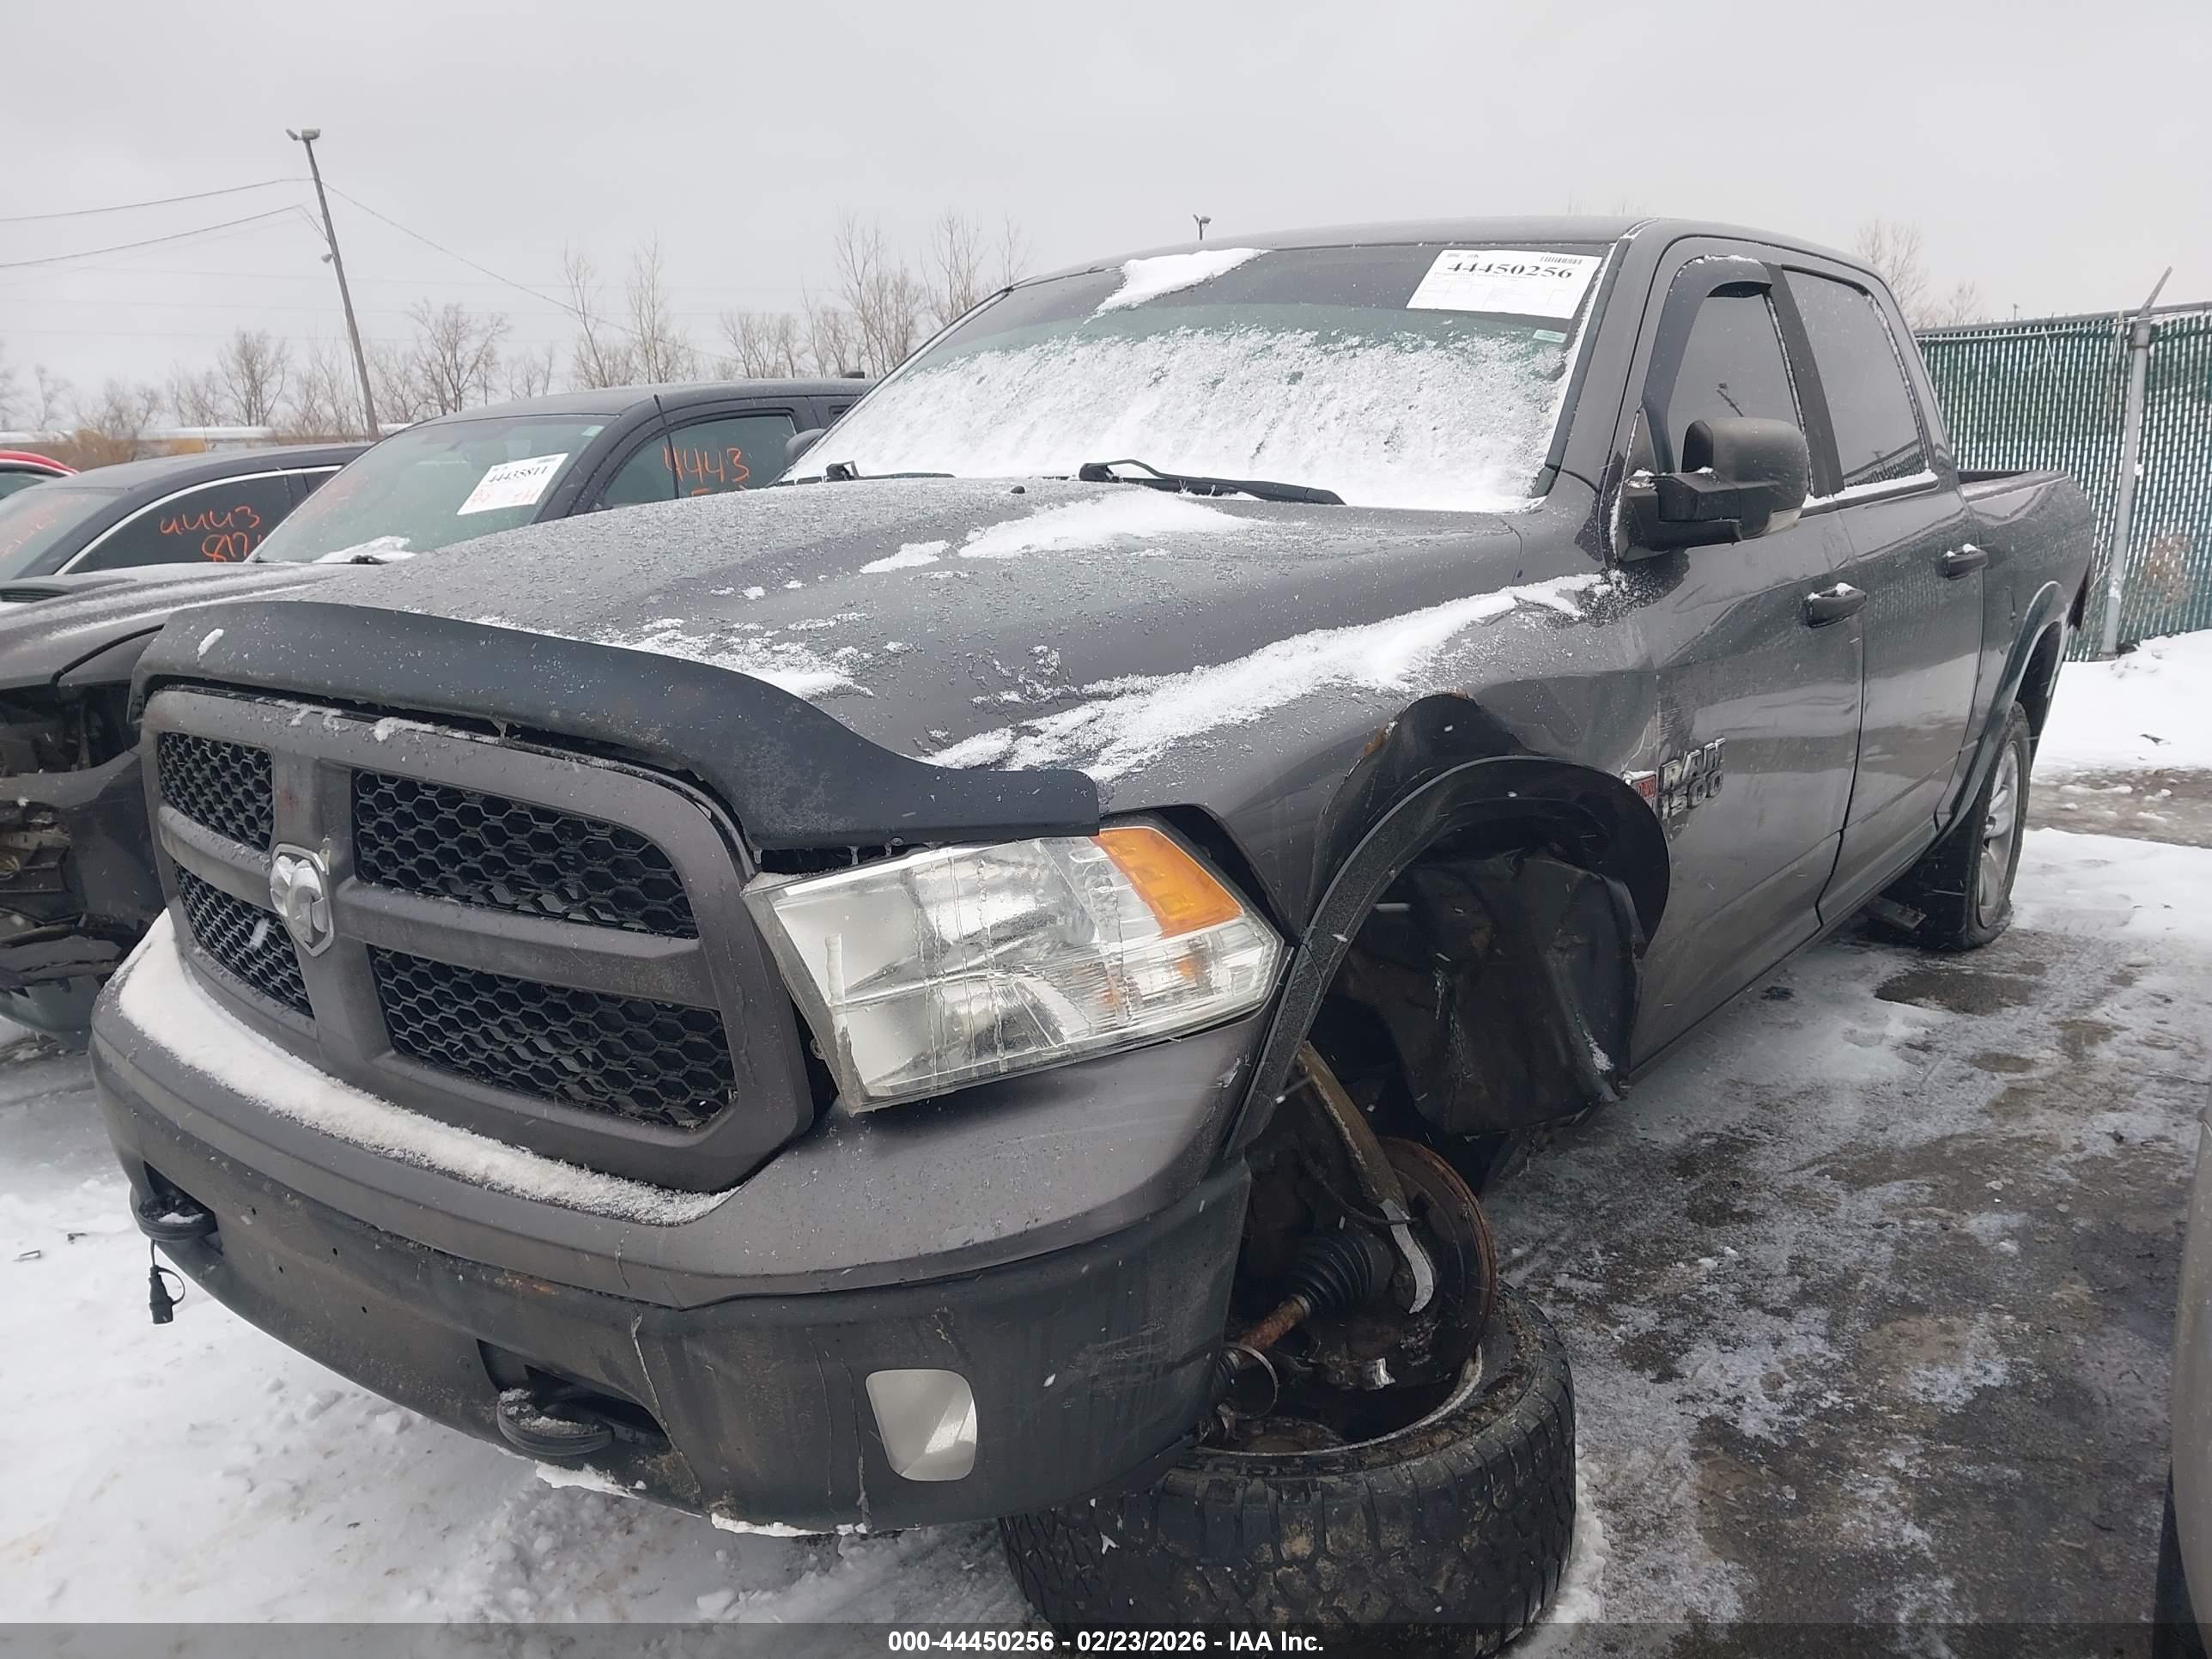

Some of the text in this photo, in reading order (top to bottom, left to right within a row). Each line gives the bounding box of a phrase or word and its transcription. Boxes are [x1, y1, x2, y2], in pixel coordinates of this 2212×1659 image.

[1446, 260, 1574, 279] 44450256
[662, 447, 750, 483] 4443
[1658, 737, 1727, 793] RAM
[1657, 770, 1724, 820] 1500
